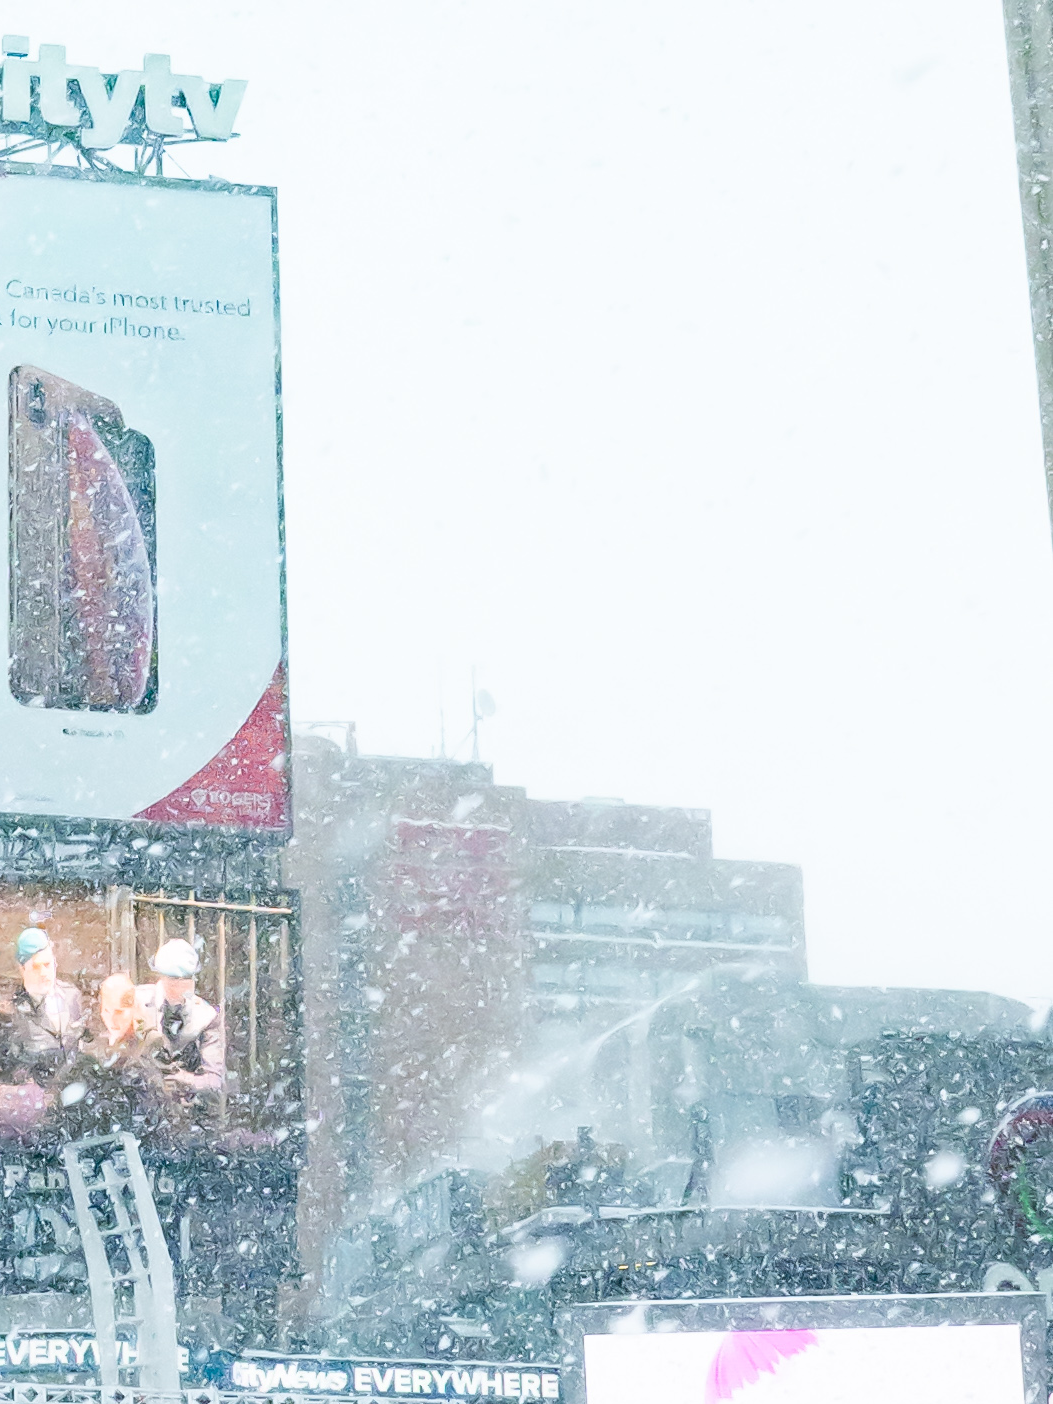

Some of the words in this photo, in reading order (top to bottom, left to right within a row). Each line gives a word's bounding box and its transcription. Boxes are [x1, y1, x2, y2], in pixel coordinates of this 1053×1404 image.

[5, 279, 107, 305] Canada's
[113, 293, 168, 311] most
[174, 295, 251, 317] trusted
[10, 307, 42, 330] for
[47, 316, 97, 336] your
[231, 1361, 346, 1392] CityNews
[353, 1367, 560, 1398] EVERYWHERE
